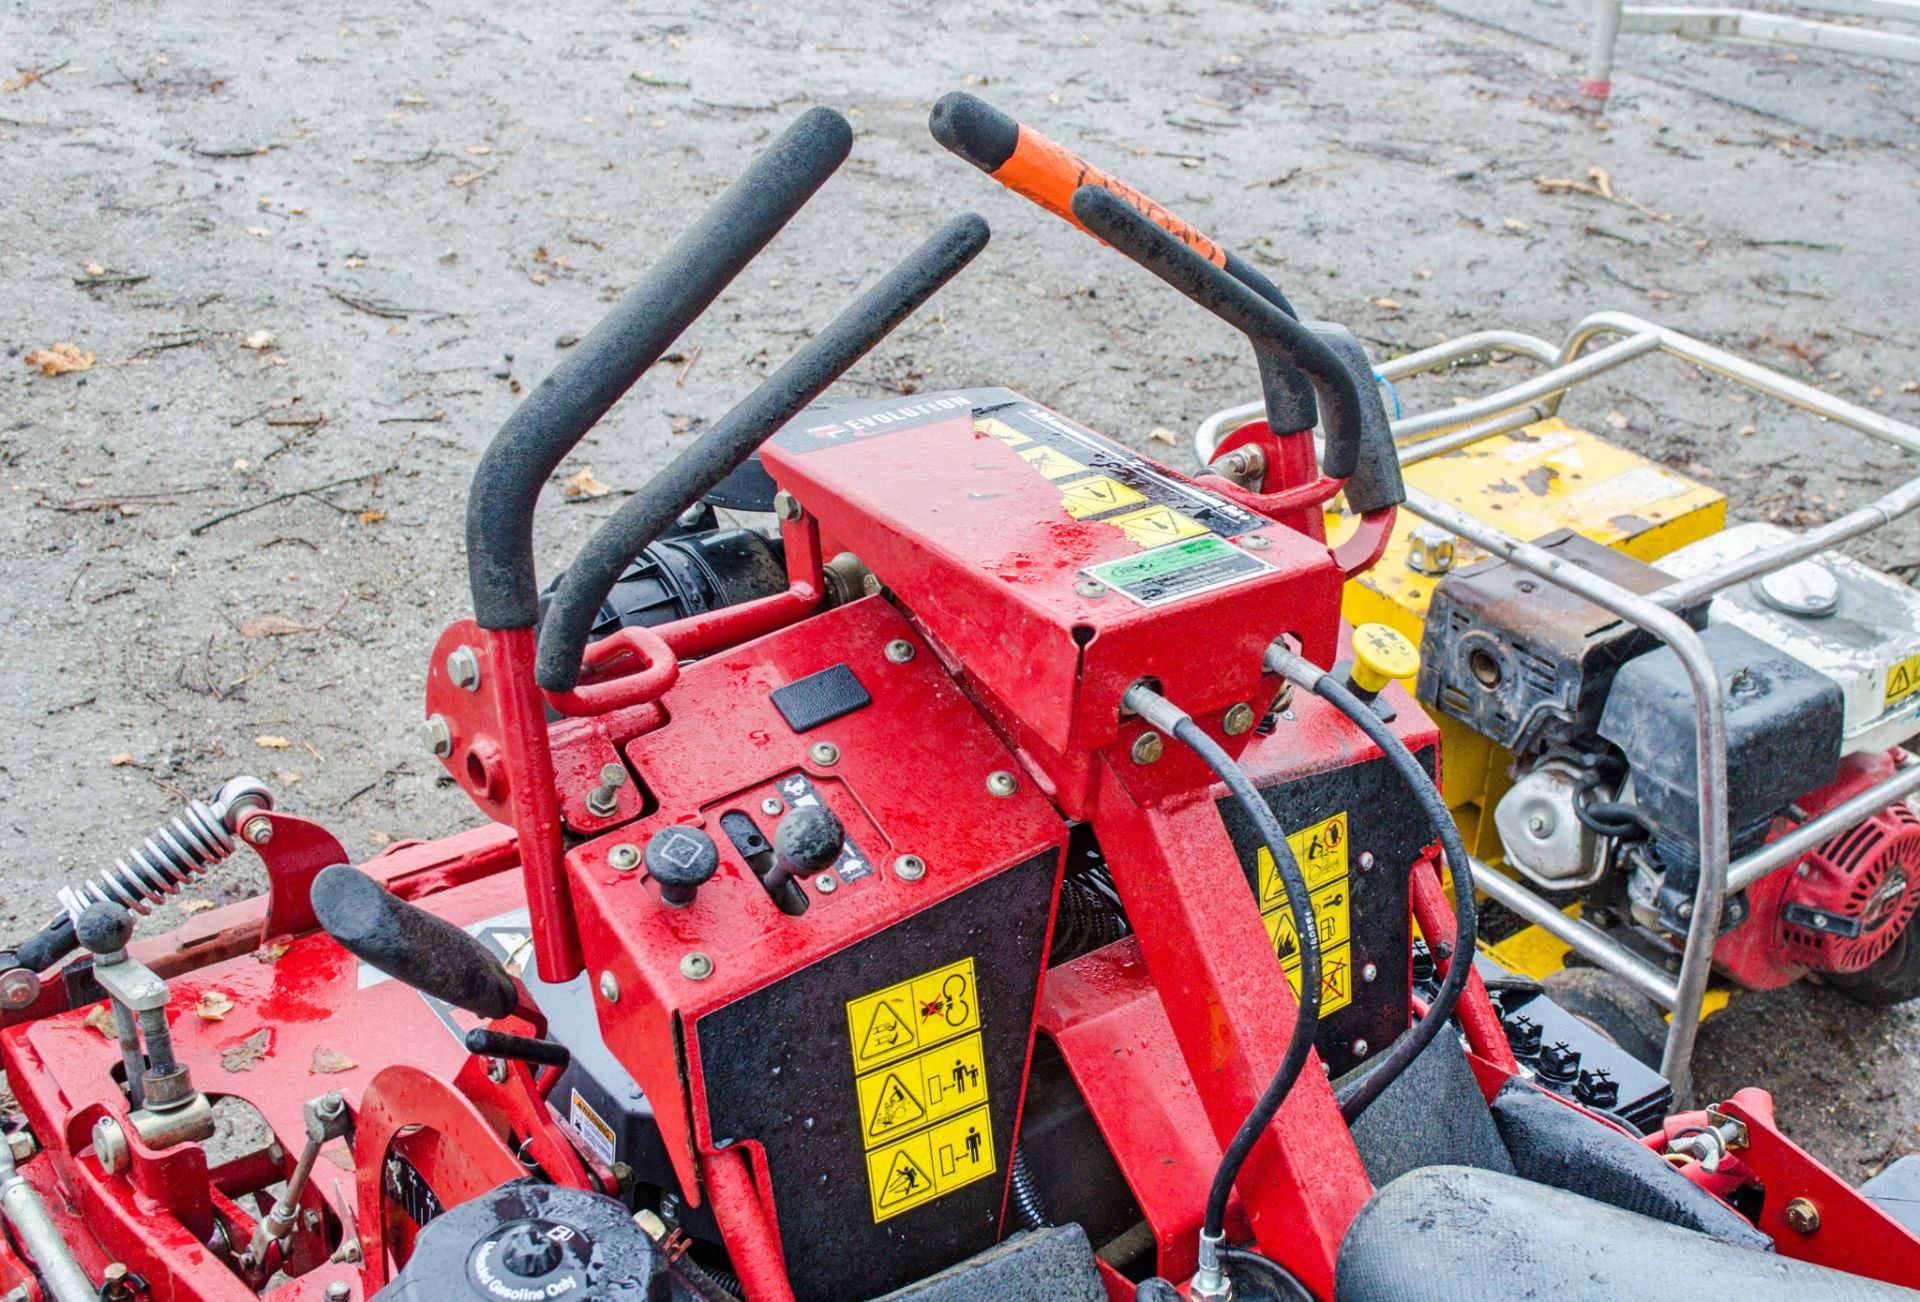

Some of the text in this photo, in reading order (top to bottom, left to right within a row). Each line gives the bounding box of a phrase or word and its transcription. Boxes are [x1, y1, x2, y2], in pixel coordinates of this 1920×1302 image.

[844, 395, 972, 430] EVOLUTION
[488, 1279, 546, 1301] Gasoline
[545, 1275, 577, 1297] Only
